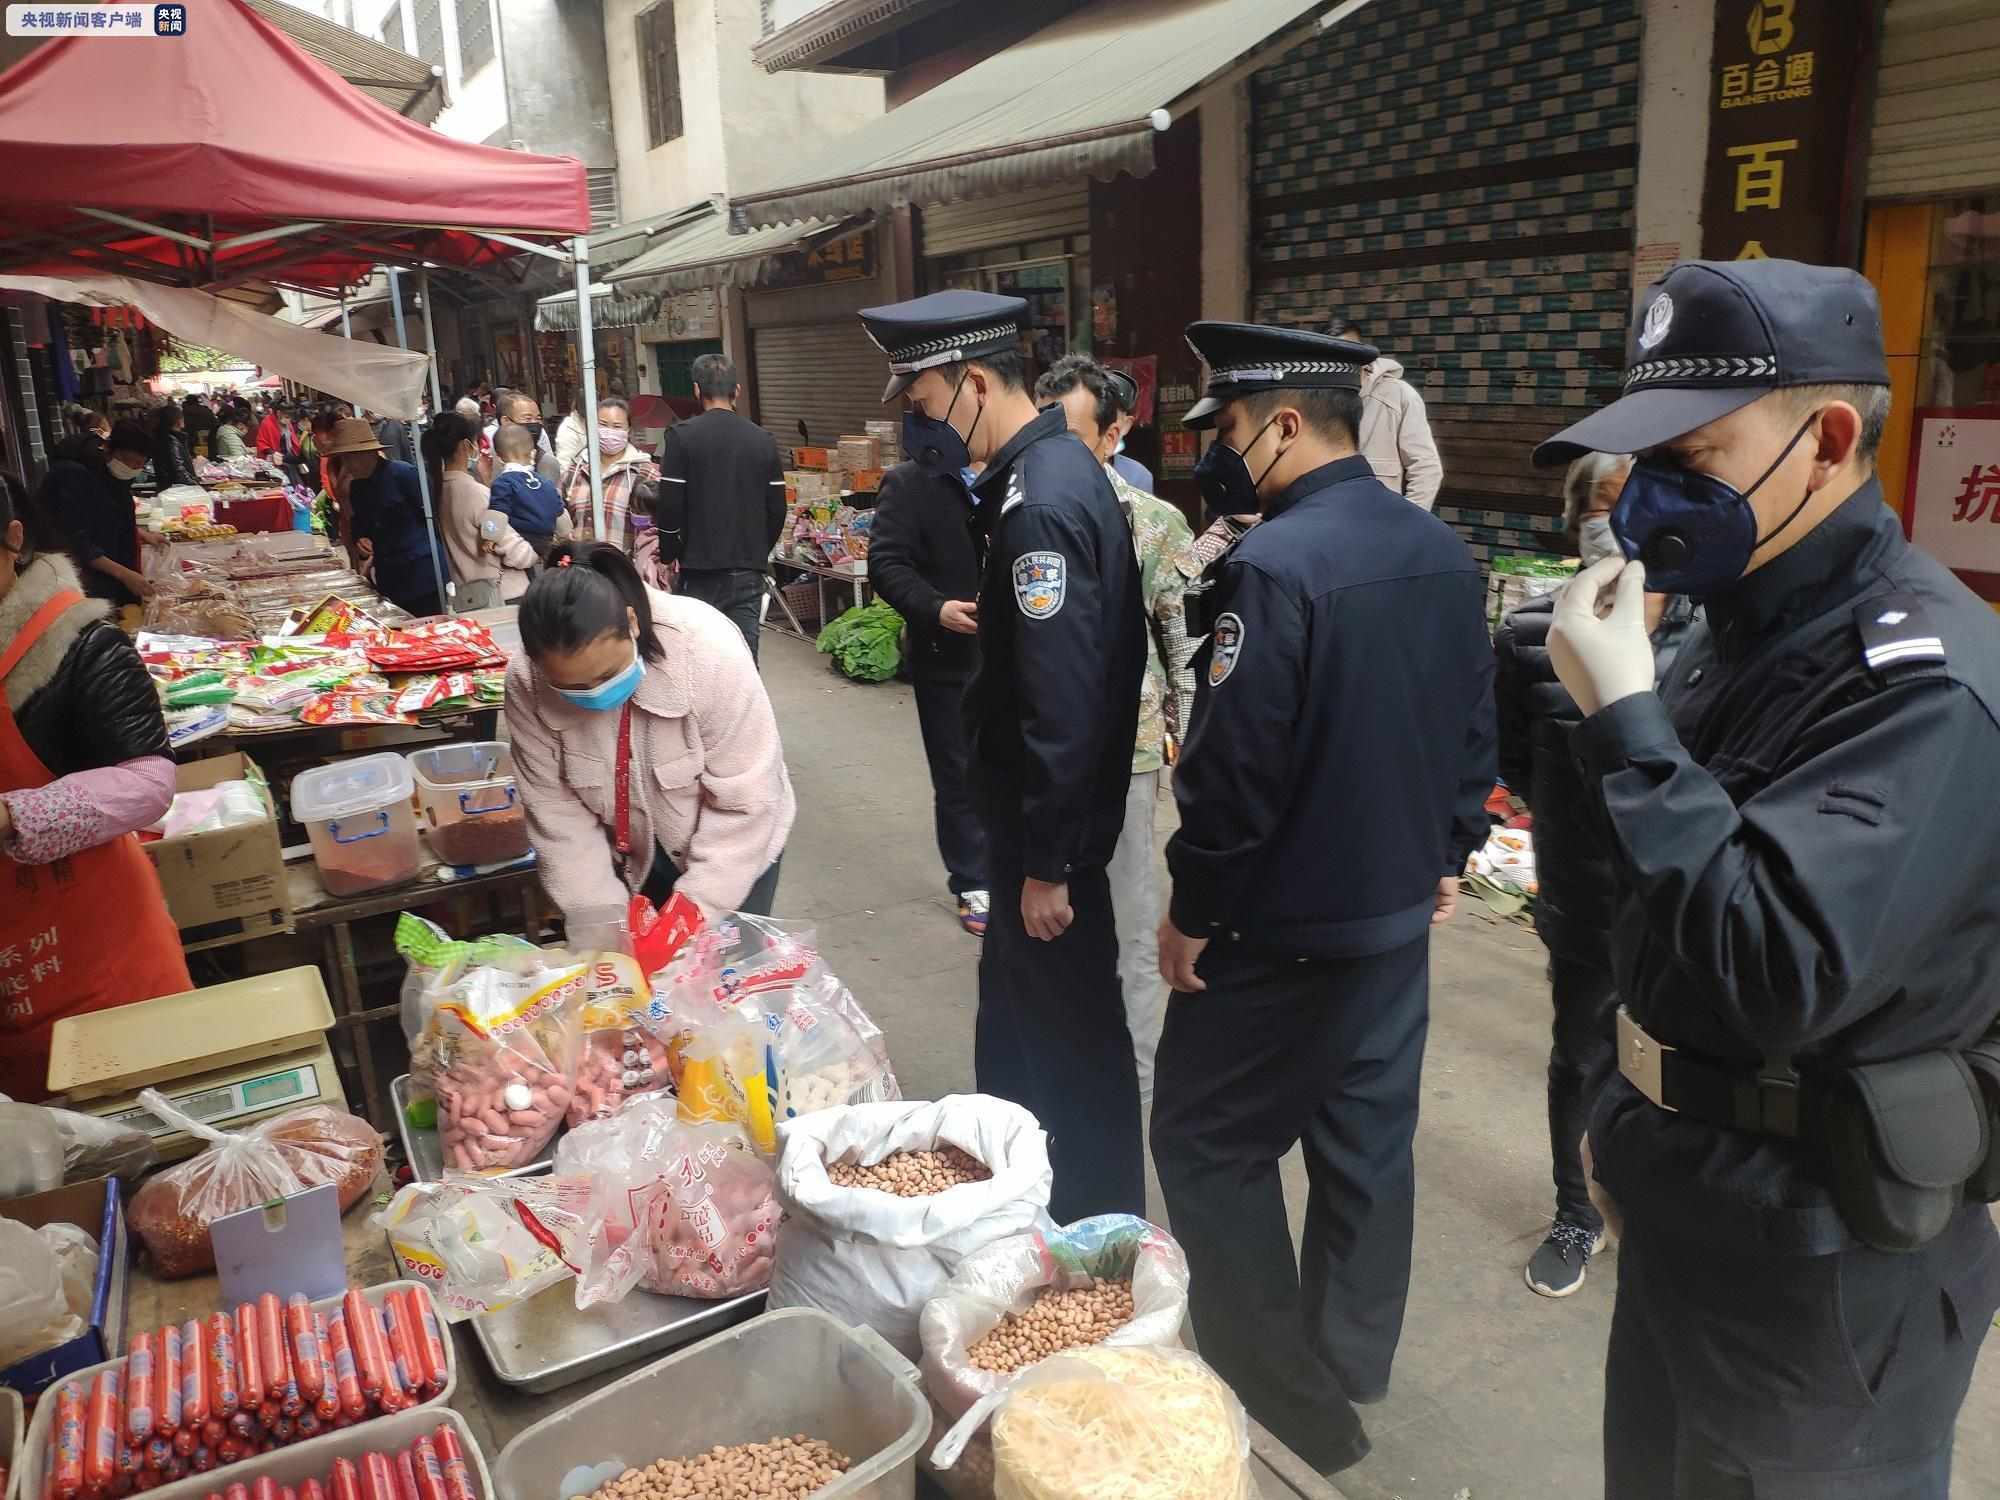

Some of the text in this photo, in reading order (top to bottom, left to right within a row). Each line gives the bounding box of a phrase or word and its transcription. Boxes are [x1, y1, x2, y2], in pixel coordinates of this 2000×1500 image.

[1721, 51, 1815, 97] 百合通
[1719, 86, 1812, 109] BAIHETONG
[1952, 464, 2000, 523] 抗
